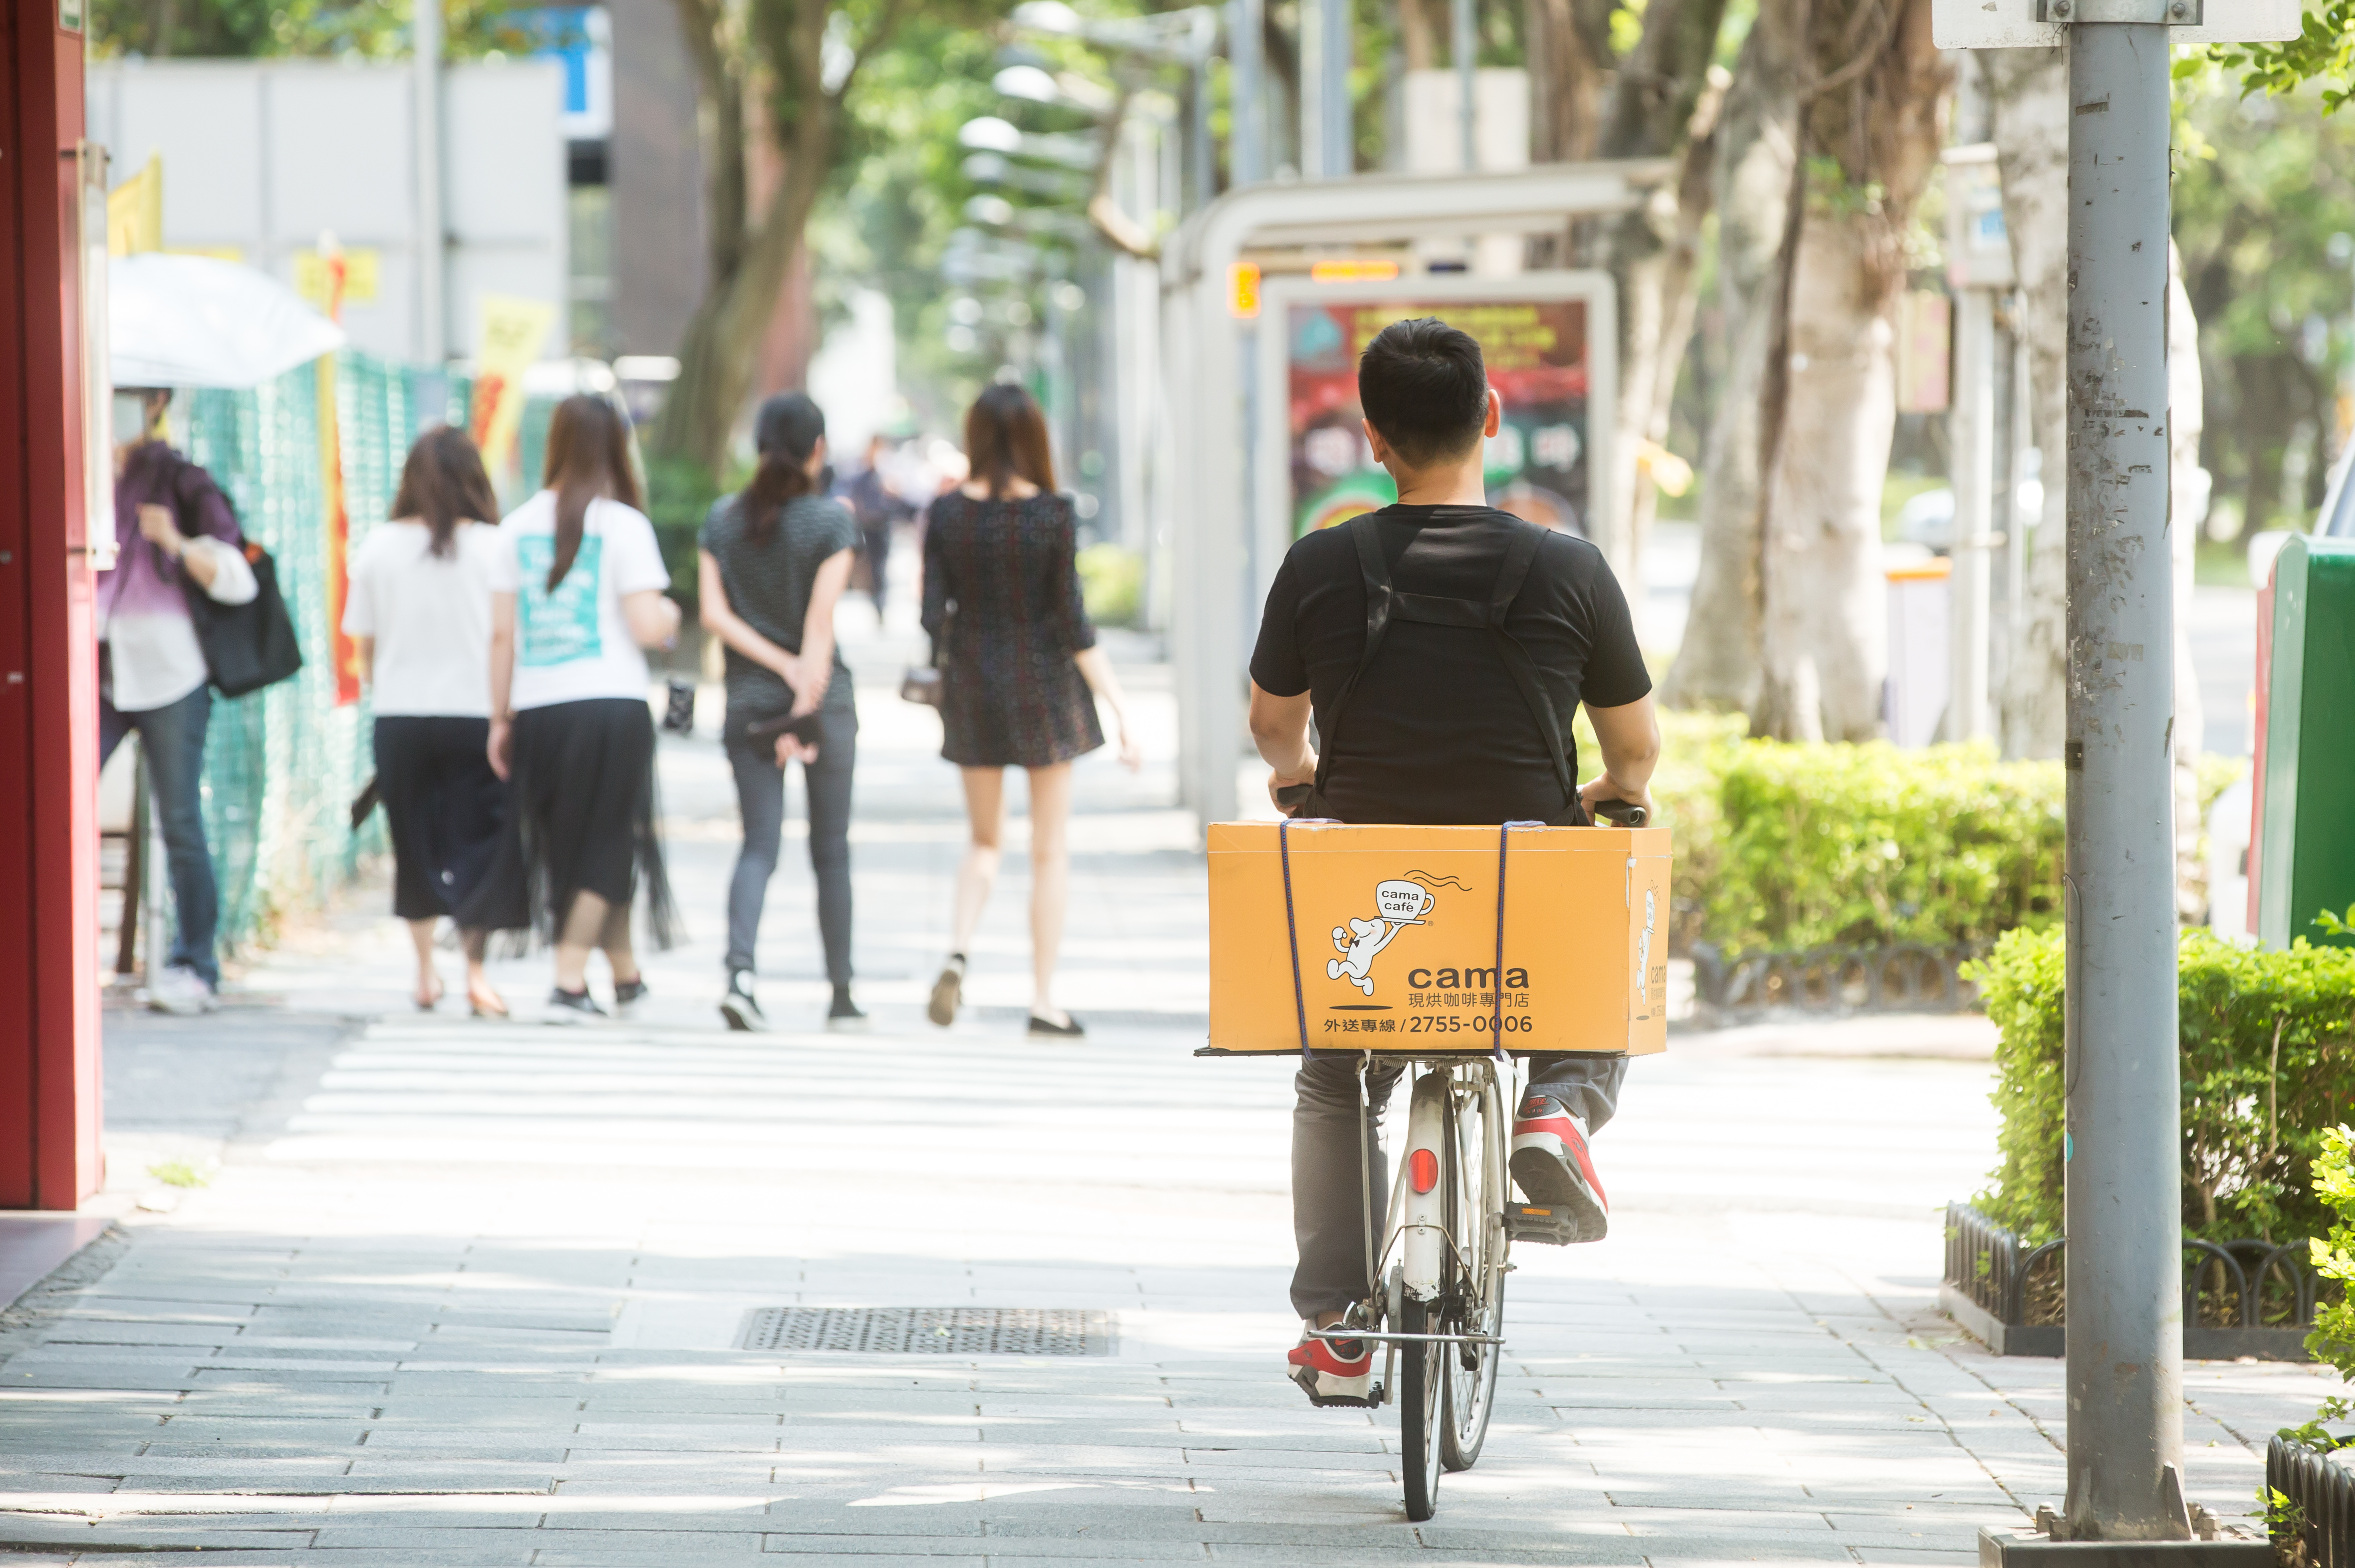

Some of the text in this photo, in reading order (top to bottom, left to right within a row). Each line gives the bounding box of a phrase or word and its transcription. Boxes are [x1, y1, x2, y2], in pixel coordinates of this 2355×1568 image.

[1382, 891, 1419, 901] cama
[1384, 902, 1414, 912] café
[1408, 968, 1529, 989] cama
[1408, 992, 1529, 1008] 現烘咖啡專門店
[1324, 1019, 1396, 1033] 外送專線
[1410, 1016, 1532, 1033] 2755-0006
